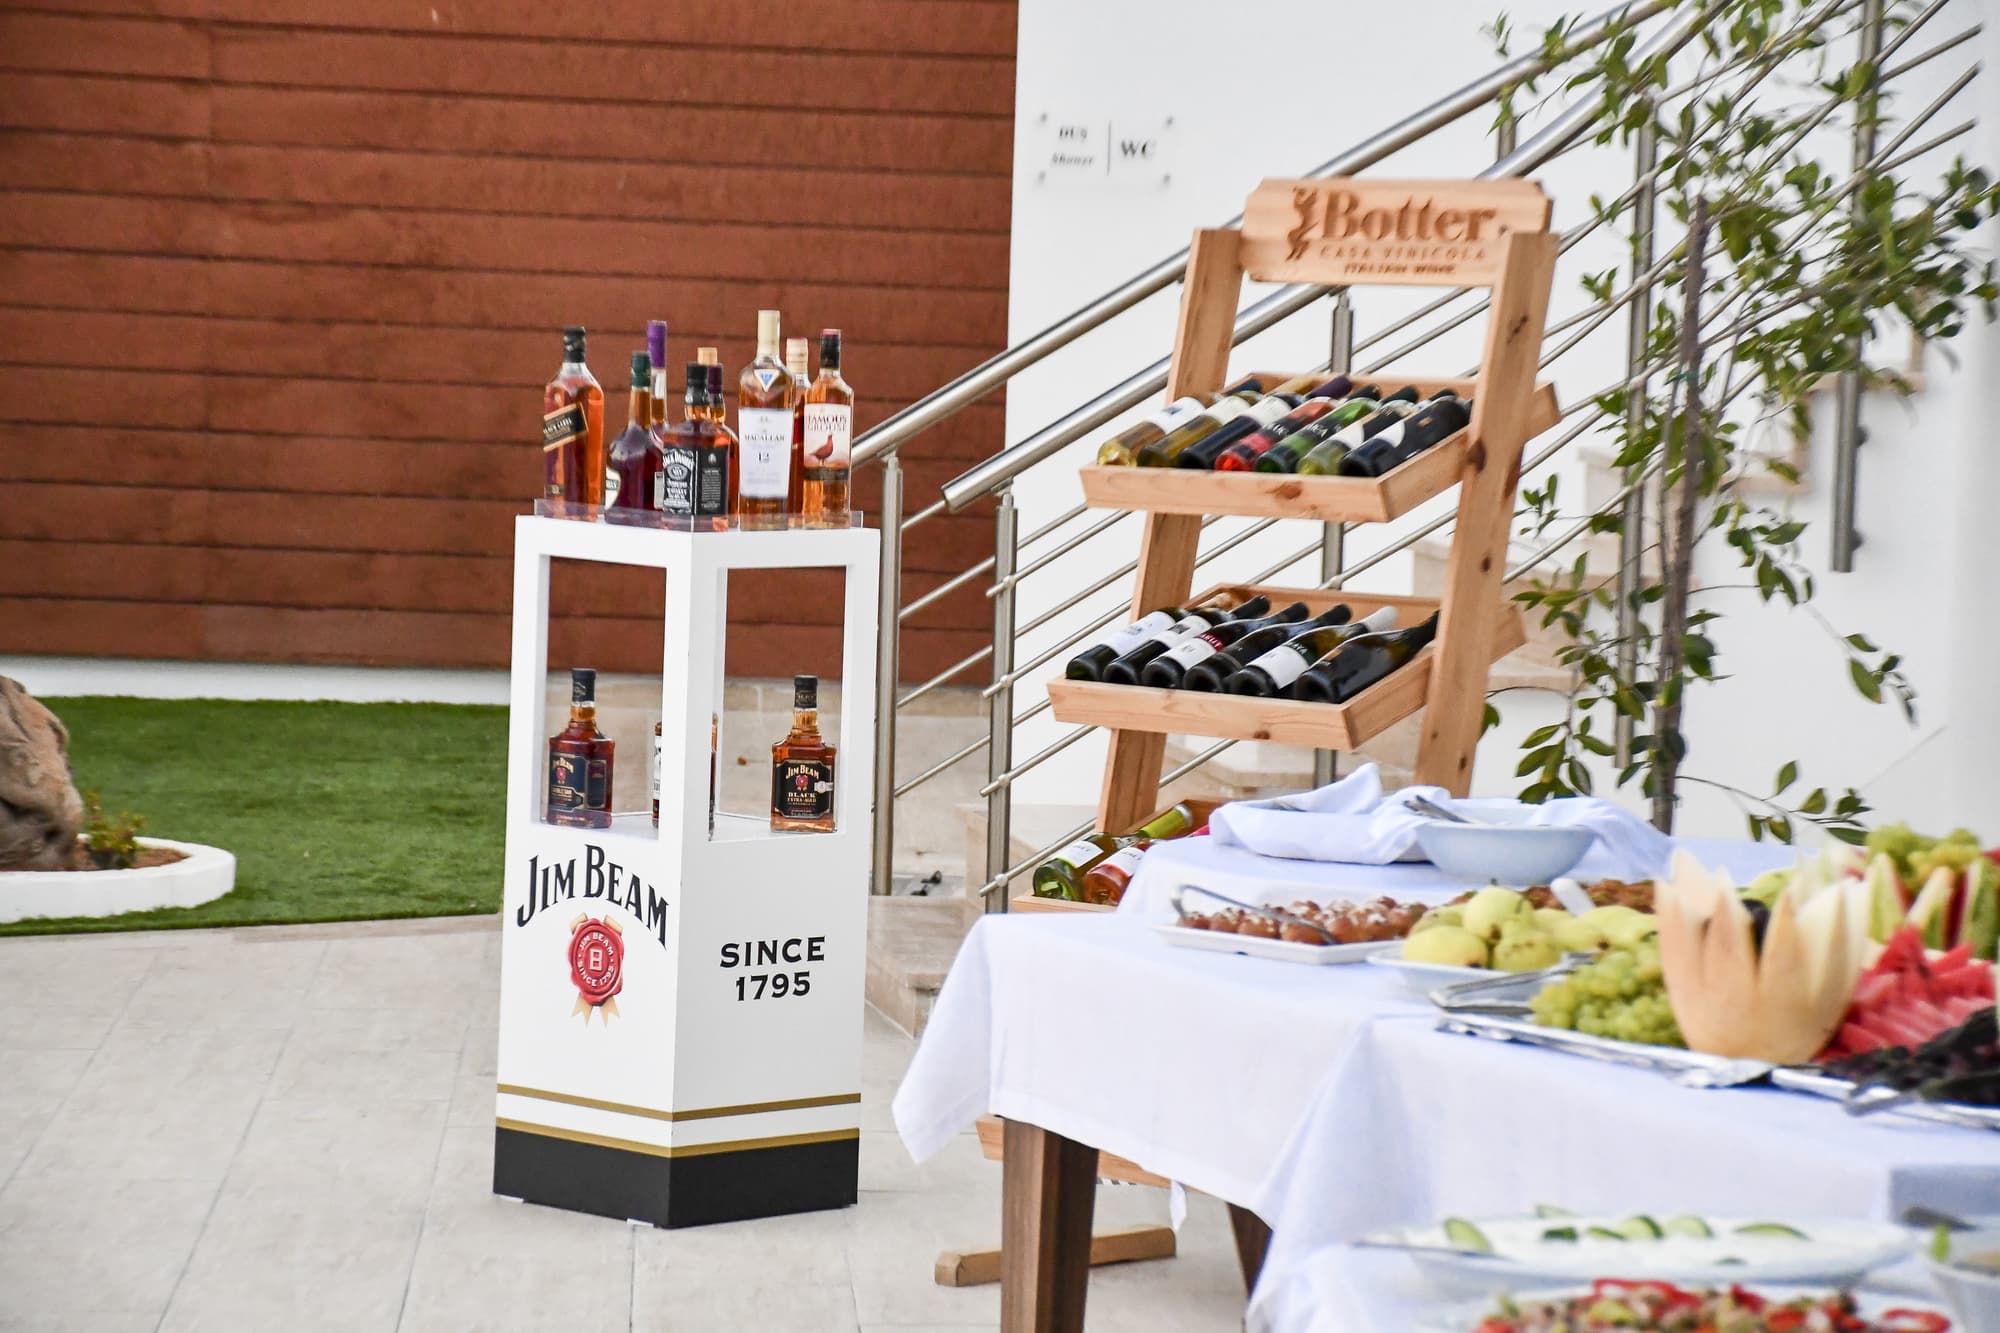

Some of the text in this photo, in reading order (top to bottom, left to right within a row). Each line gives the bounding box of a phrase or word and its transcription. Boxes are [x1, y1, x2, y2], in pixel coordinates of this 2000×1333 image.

[1322, 191, 1497, 242] Botter
[1320, 246, 1486, 260] CASA VINICOLA
[807, 415, 847, 424] FAMOUS
[744, 433, 785, 441] MACALLAN
[800, 764, 819, 779] BEAM
[517, 843, 670, 952] JIM BEAM
[579, 932, 614, 956] JIM BEAM
[719, 935, 826, 969] SINCE
[577, 960, 614, 987] SINCE 1795
[735, 970, 811, 1002] 1795
